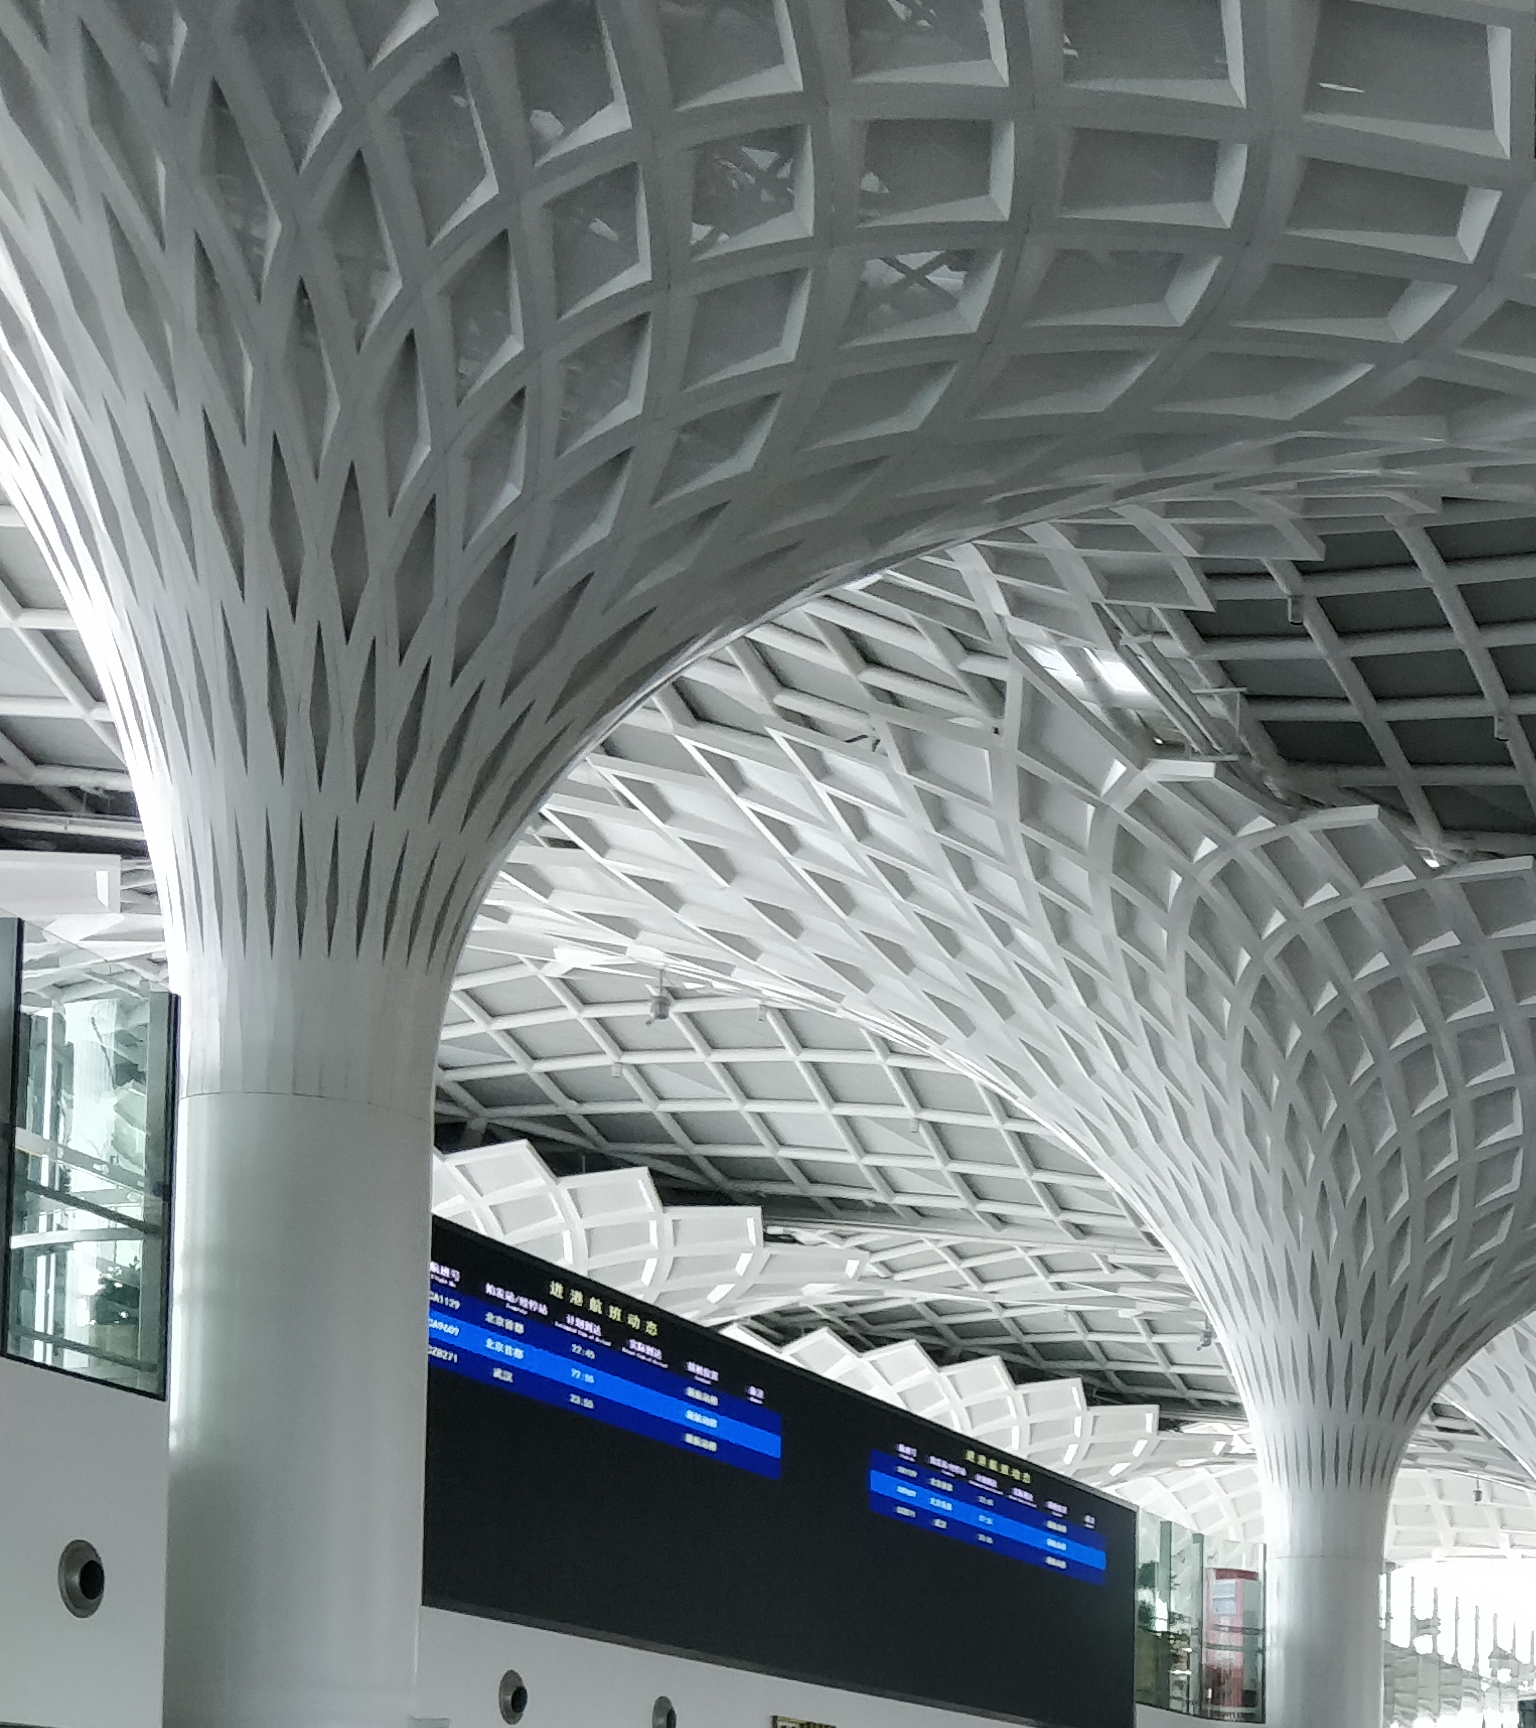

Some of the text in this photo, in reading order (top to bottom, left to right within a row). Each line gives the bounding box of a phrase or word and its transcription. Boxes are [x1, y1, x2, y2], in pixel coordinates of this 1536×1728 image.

[549, 1280, 659, 1337] 进港航班动态
